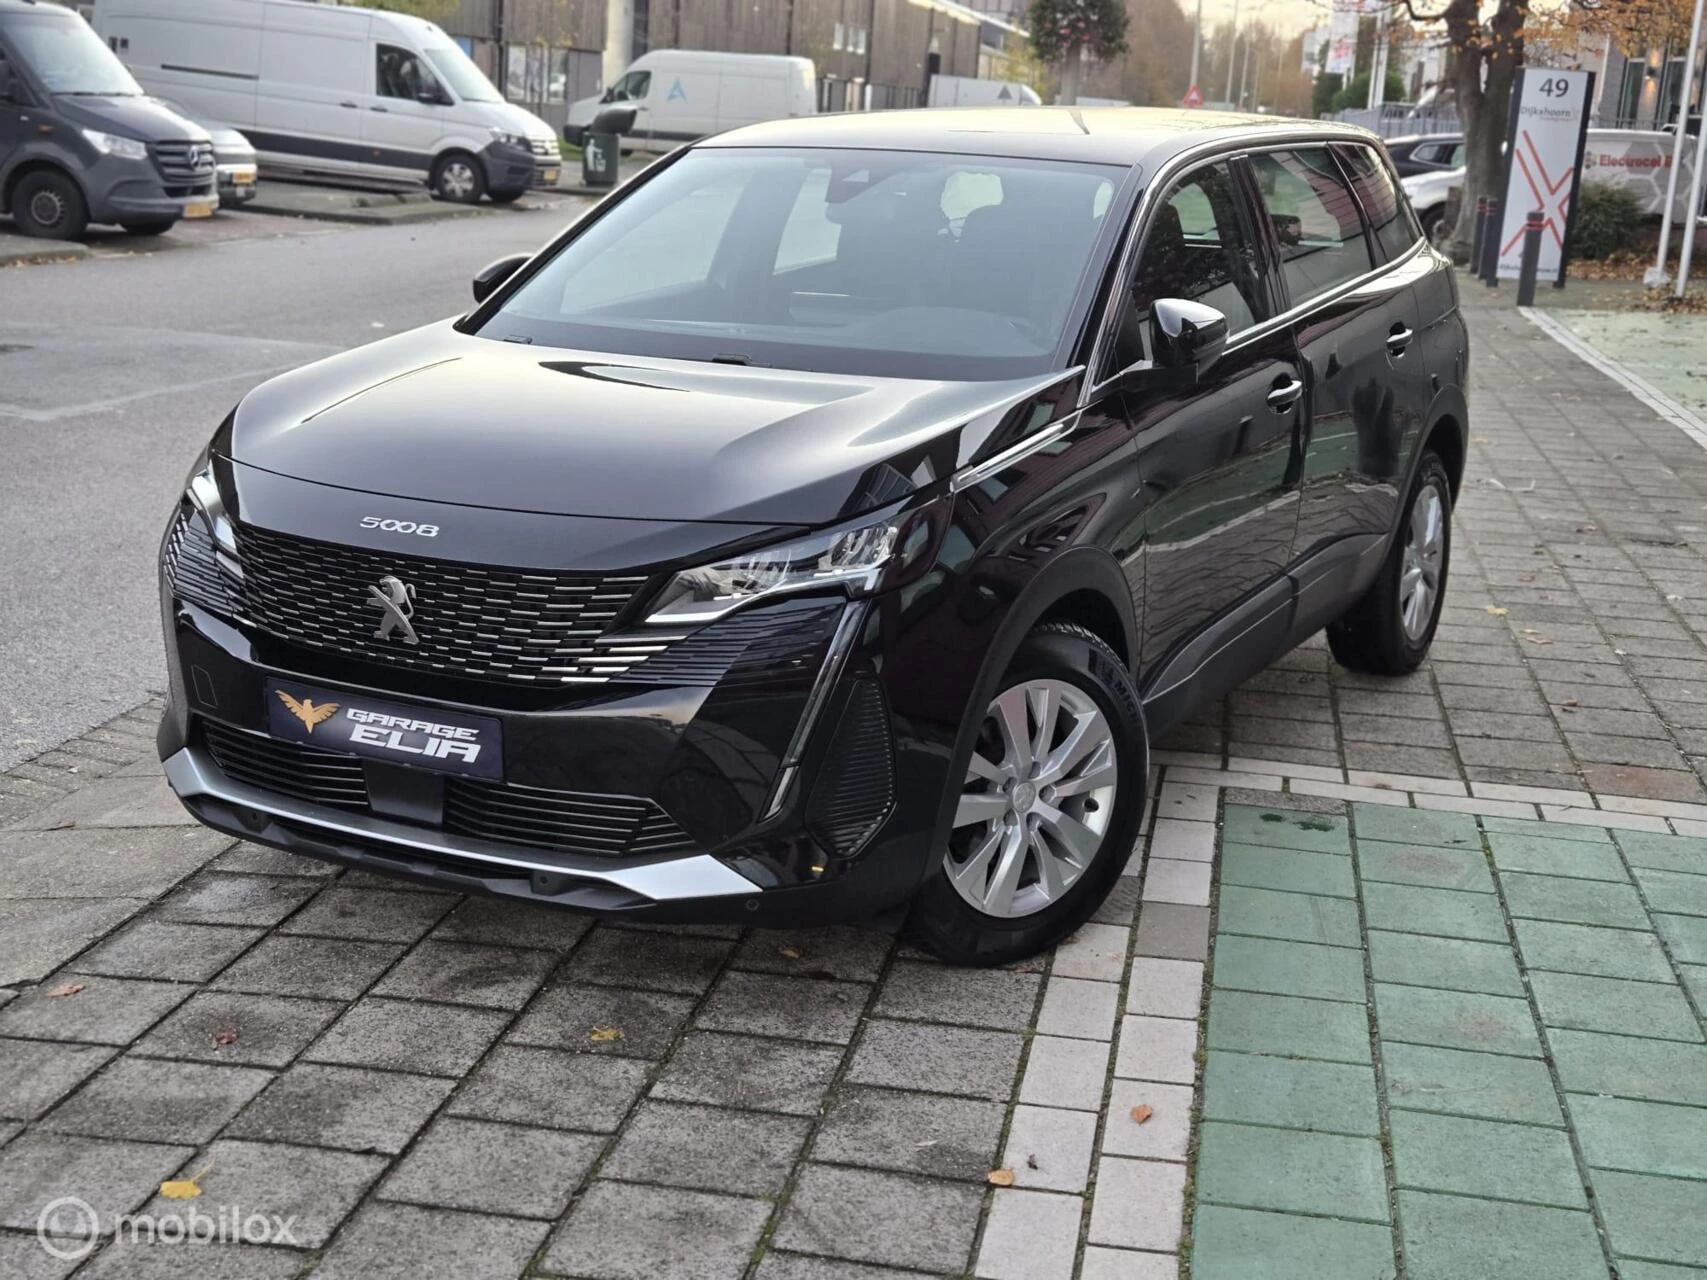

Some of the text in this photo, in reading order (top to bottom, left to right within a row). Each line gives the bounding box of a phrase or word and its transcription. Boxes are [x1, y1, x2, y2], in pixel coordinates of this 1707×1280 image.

[1539, 78, 1569, 98] 49
[360, 516, 440, 537] 5008
[346, 708, 479, 741] GARAGE
[349, 723, 481, 763] ELIA
